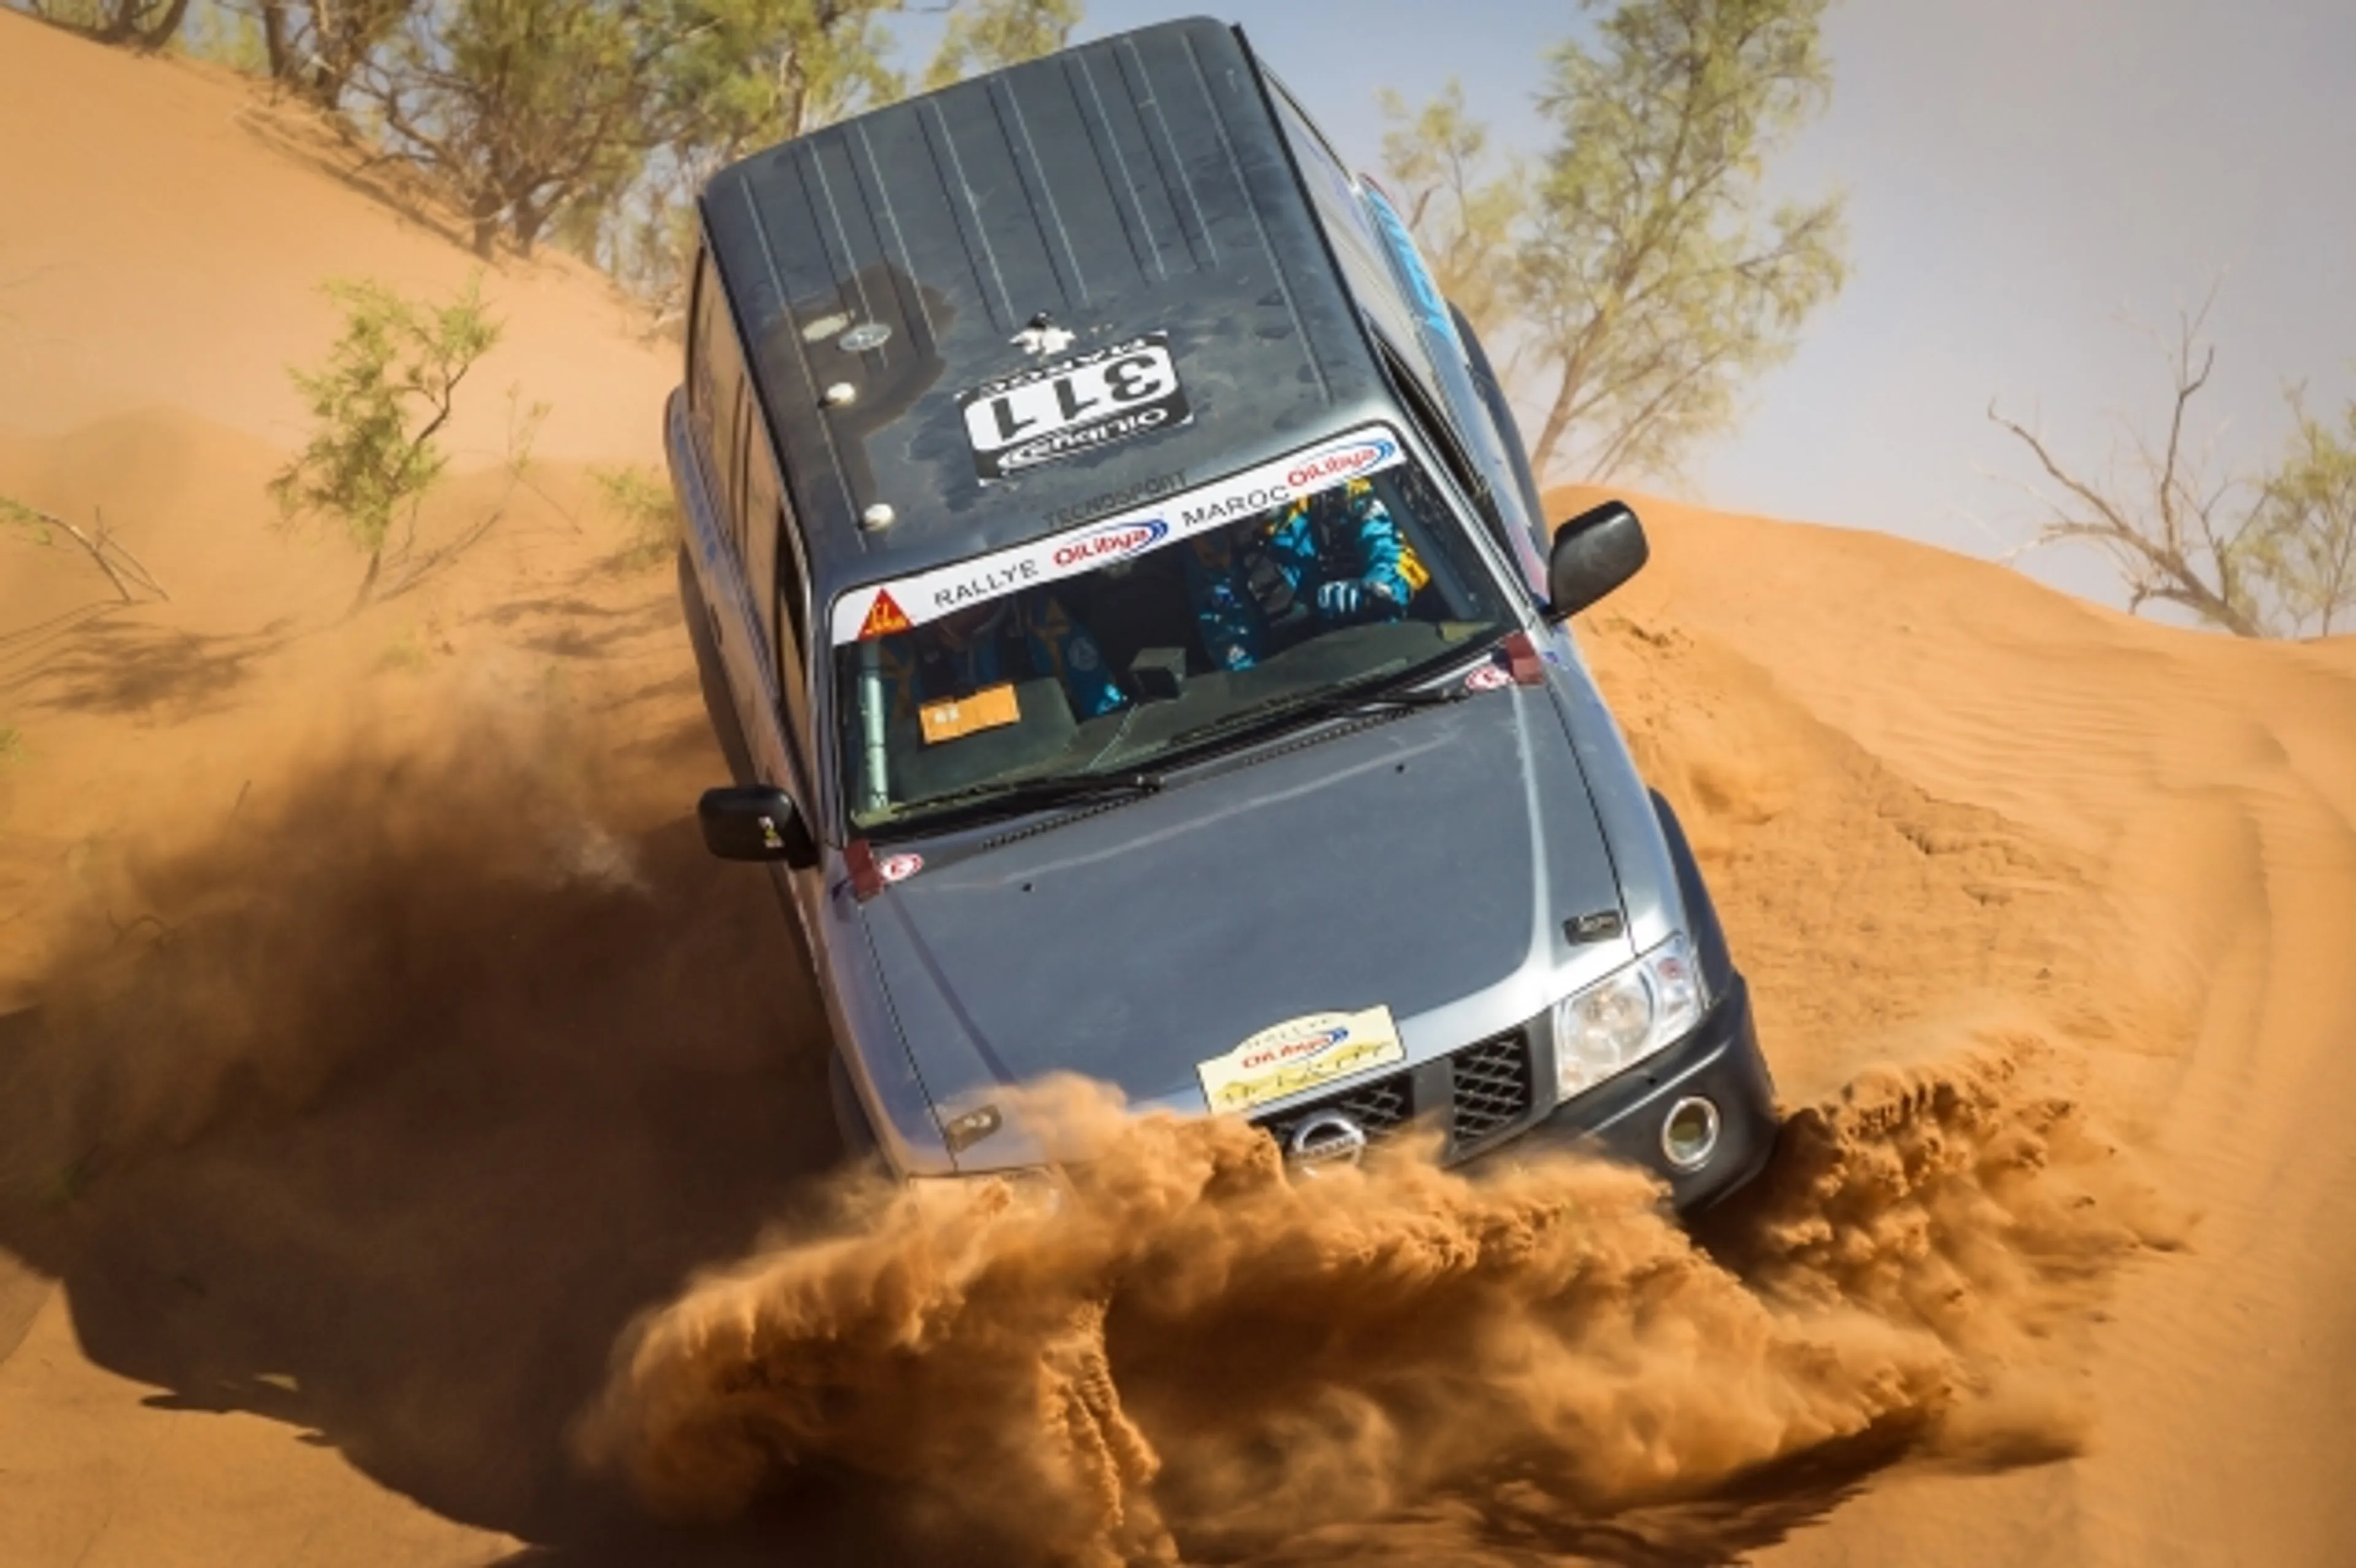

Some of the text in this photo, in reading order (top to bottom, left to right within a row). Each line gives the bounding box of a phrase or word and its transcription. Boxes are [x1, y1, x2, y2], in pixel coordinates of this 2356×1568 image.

[989, 354, 1162, 442] 311
[934, 559, 1039, 608] RALLYE
[1182, 485, 1290, 527] MAROC
